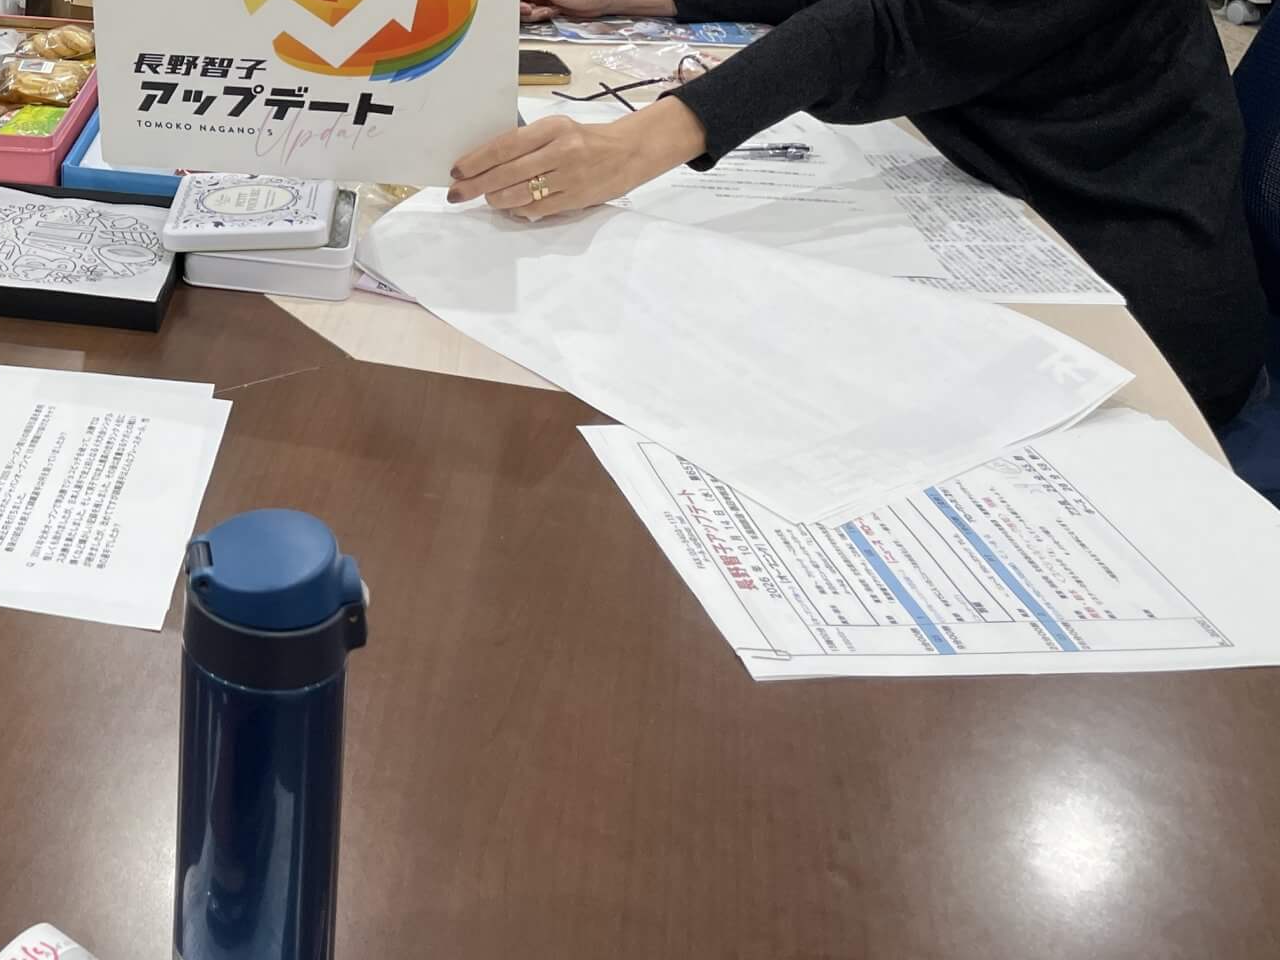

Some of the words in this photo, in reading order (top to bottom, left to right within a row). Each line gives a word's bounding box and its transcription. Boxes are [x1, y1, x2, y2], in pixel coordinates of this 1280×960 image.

[133, 52, 268, 81] 長野智子
[136, 119, 193, 132] TOMOKO
[137, 81, 395, 126] アップデート
[256, 108, 386, 166] Update
[673, 488, 761, 590] 長野智子アップデート
